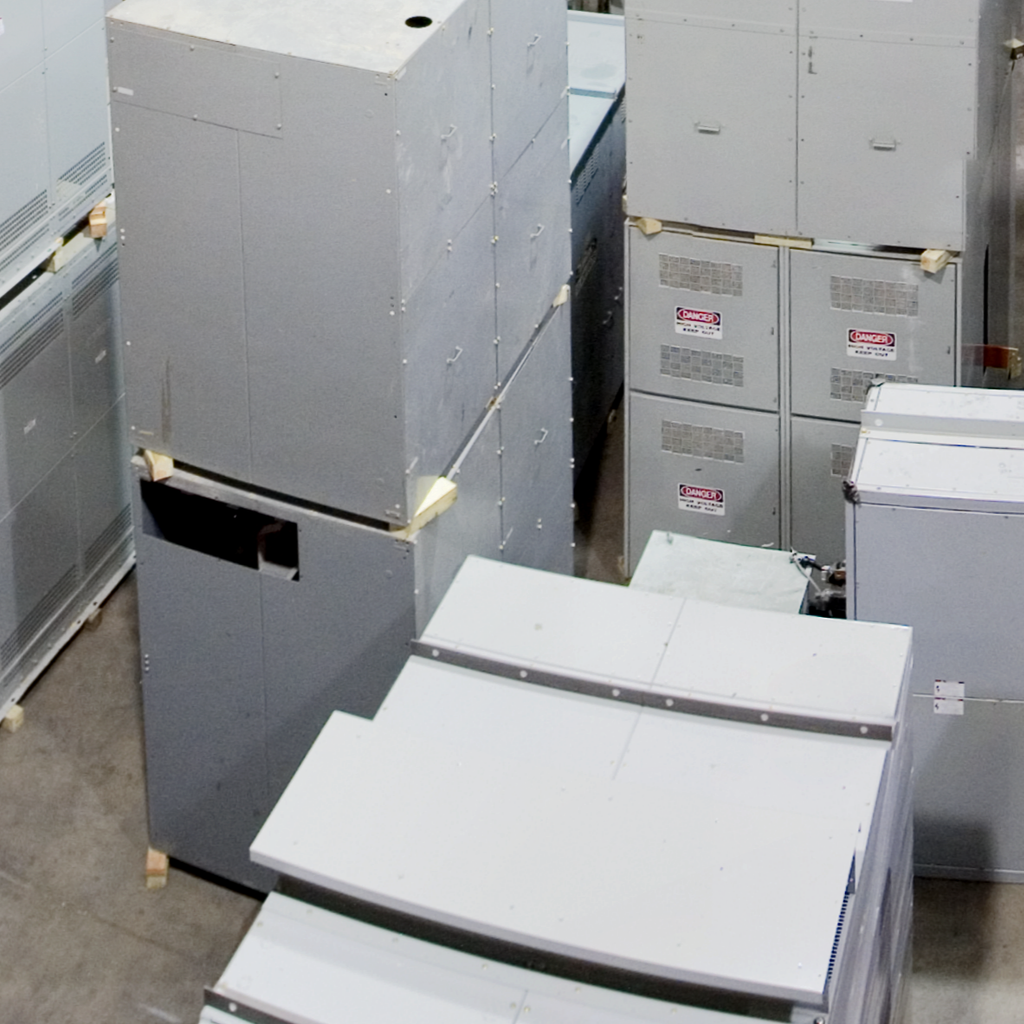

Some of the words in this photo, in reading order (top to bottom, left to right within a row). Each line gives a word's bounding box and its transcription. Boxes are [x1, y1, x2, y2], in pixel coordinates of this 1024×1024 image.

[683, 309, 713, 323] DANGER
[856, 331, 887, 345] DANGER
[686, 487, 716, 500] DANGER
